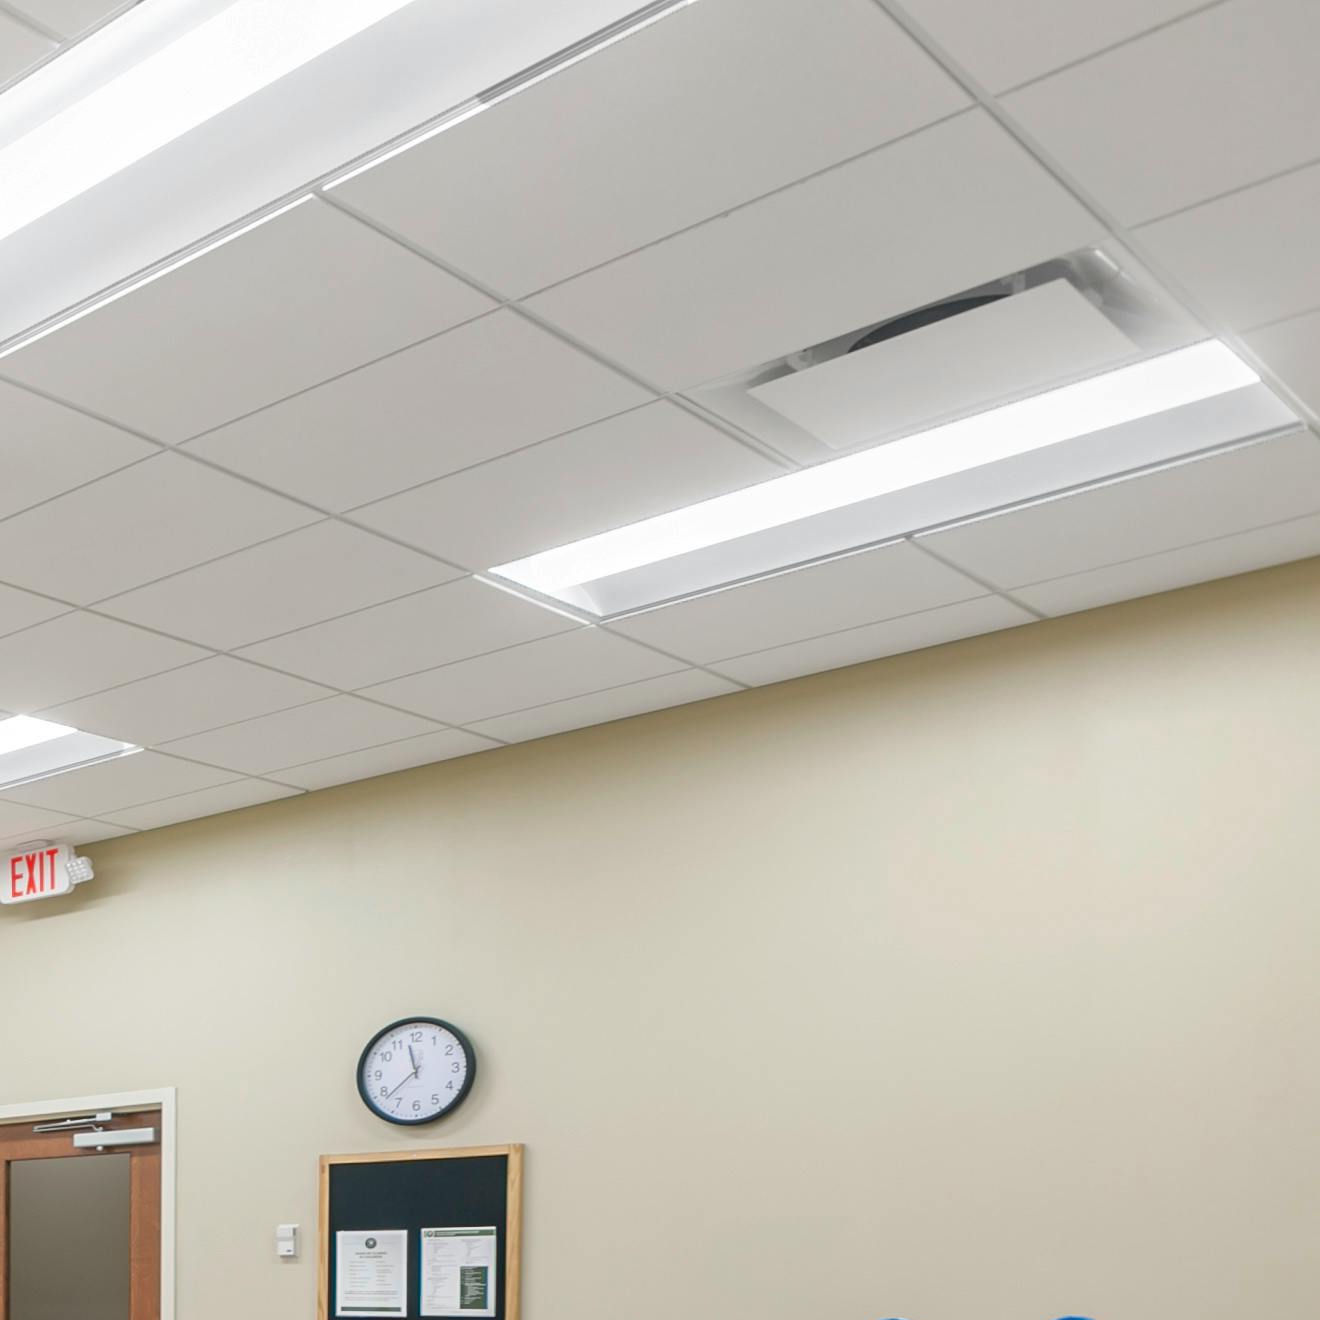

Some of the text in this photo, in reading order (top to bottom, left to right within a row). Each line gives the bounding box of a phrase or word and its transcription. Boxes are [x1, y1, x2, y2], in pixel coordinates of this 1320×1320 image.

[10, 848, 59, 897] EXIT
[410, 1031, 423, 1042] 12
[432, 1035, 437, 1046] 1
[392, 1039, 402, 1050] 11
[444, 1044, 454, 1056] 2
[380, 1051, 392, 1063] 10
[451, 1062, 460, 1074] 3
[374, 1070, 383, 1081] 9
[445, 1080, 454, 1090] 4
[380, 1086, 388, 1097] 8
[395, 1097, 403, 1108] 7
[431, 1094, 440, 1105] 5
[412, 1100, 421, 1111] 6
